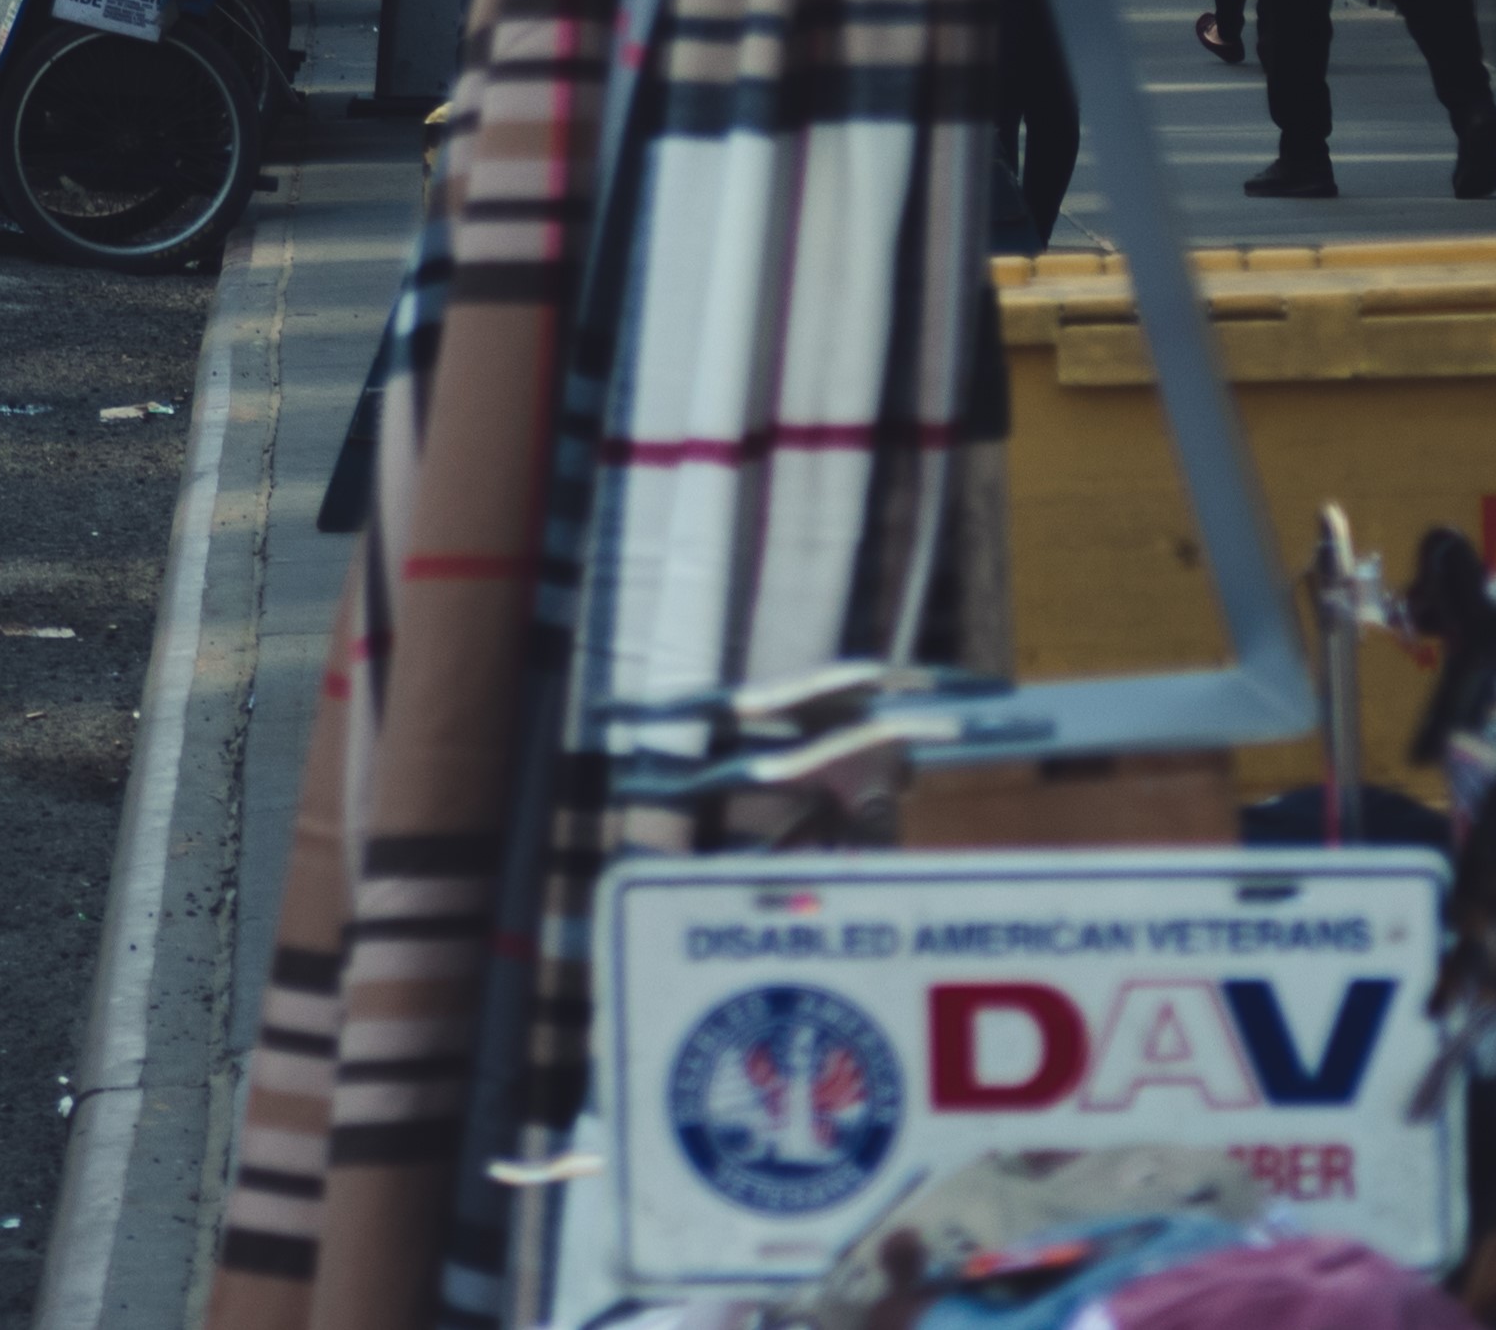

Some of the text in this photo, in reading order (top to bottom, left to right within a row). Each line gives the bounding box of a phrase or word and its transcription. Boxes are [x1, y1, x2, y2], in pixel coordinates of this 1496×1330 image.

[684, 915, 1373, 964] DISABLED AMERICAN VETERANS
[925, 976, 1398, 1116] DAV
